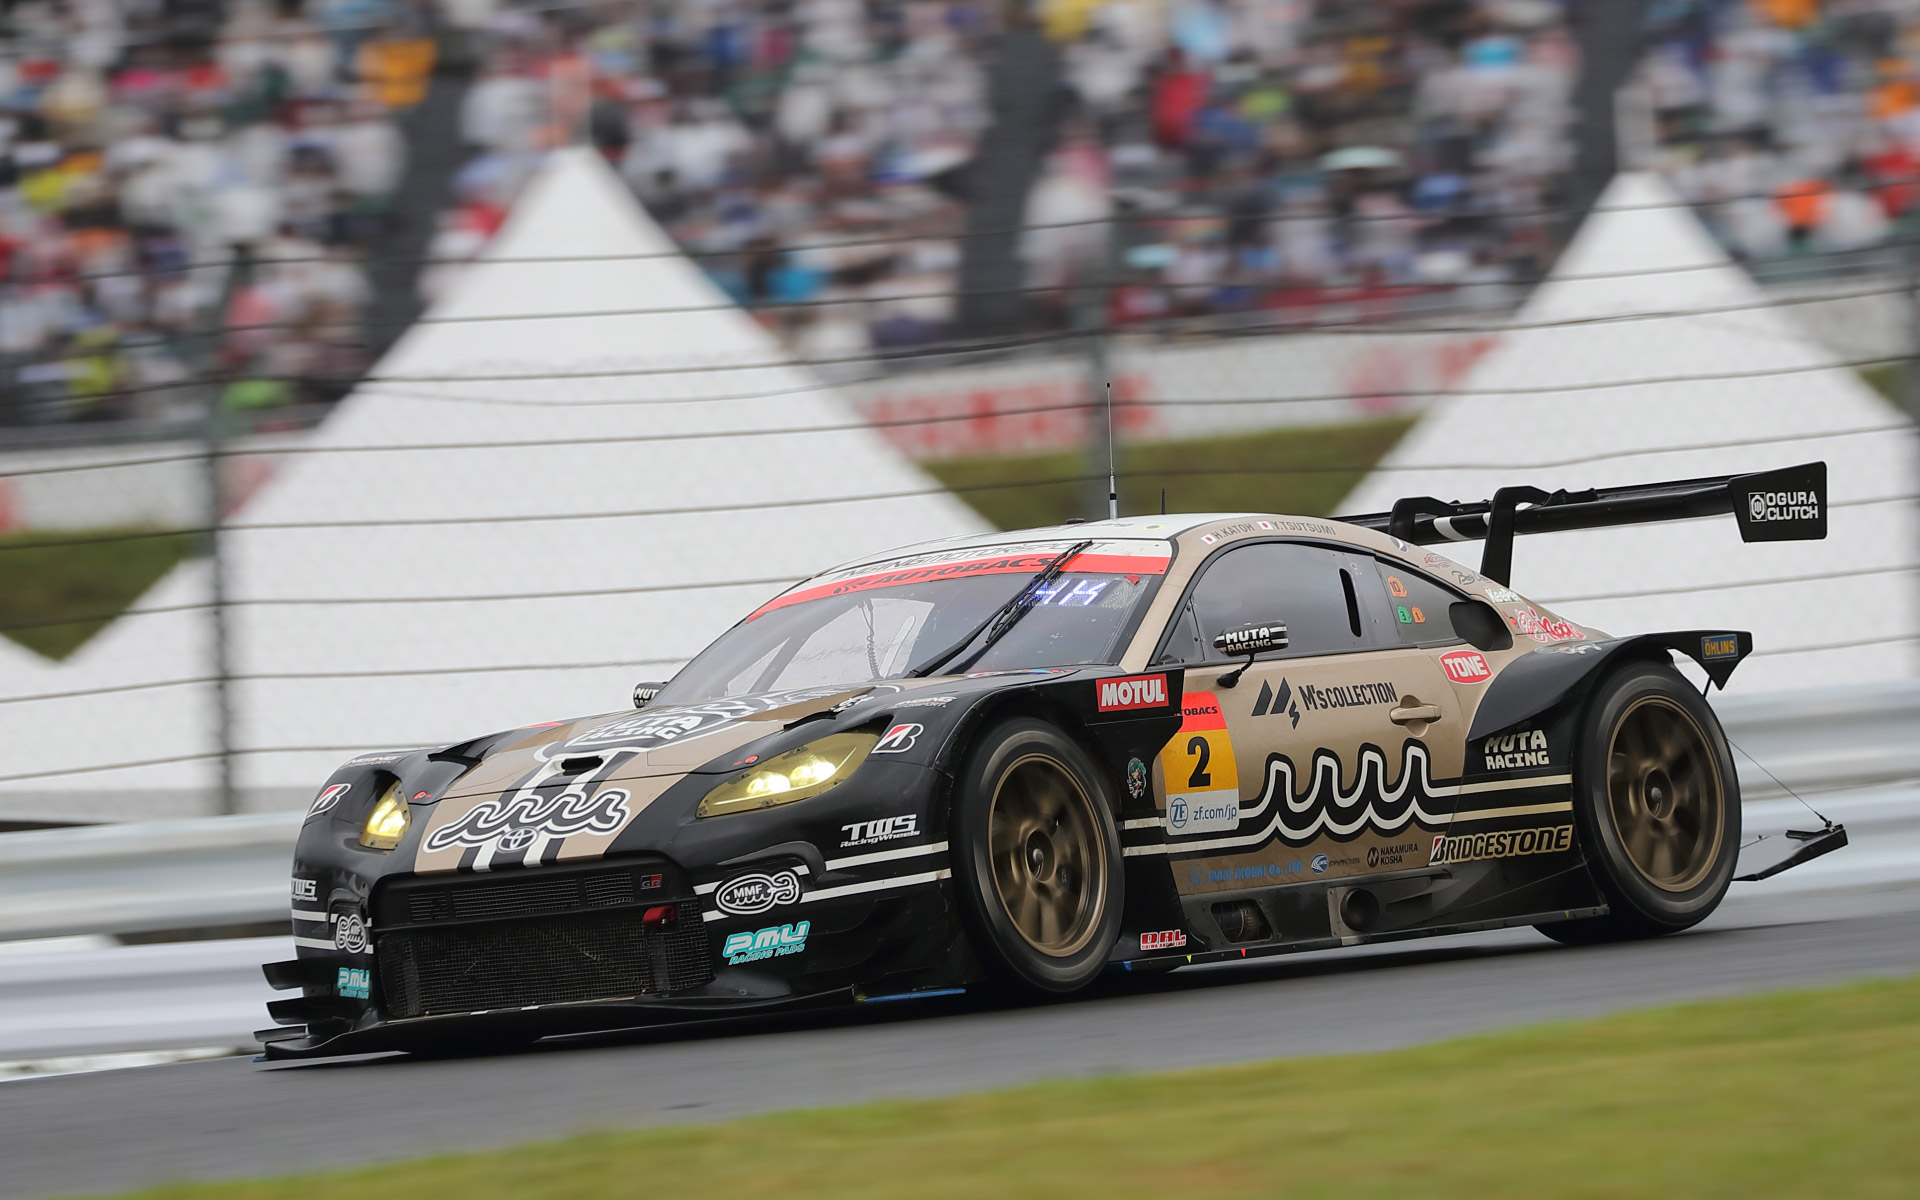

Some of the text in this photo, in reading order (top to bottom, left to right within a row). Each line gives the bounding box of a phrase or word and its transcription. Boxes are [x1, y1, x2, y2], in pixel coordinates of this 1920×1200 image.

[1766, 491, 1818, 506] OGURA
[1767, 505, 1819, 521] CLUTCH
[1212, 522, 1256, 540] H.KATOH
[1272, 521, 1337, 536] Y.TSUTSUMI
[1225, 627, 1270, 644] MUTA
[1227, 638, 1272, 652] RACING
[1443, 655, 1488, 678] TONE
[634, 687, 660, 700] MUT
[1101, 679, 1165, 707] MOTUL
[1484, 729, 1548, 754] MUTA
[1187, 736, 1211, 788] 2
[1485, 750, 1550, 770] RACING
[1193, 804, 1238, 821] zf.com/jp
[841, 813, 917, 841] TWS
[1380, 843, 1419, 856] NAKAMURA
[1428, 824, 1574, 866] BRIDGESTONE
[1380, 855, 1403, 866] KOSHA
[733, 884, 763, 899] MMF
